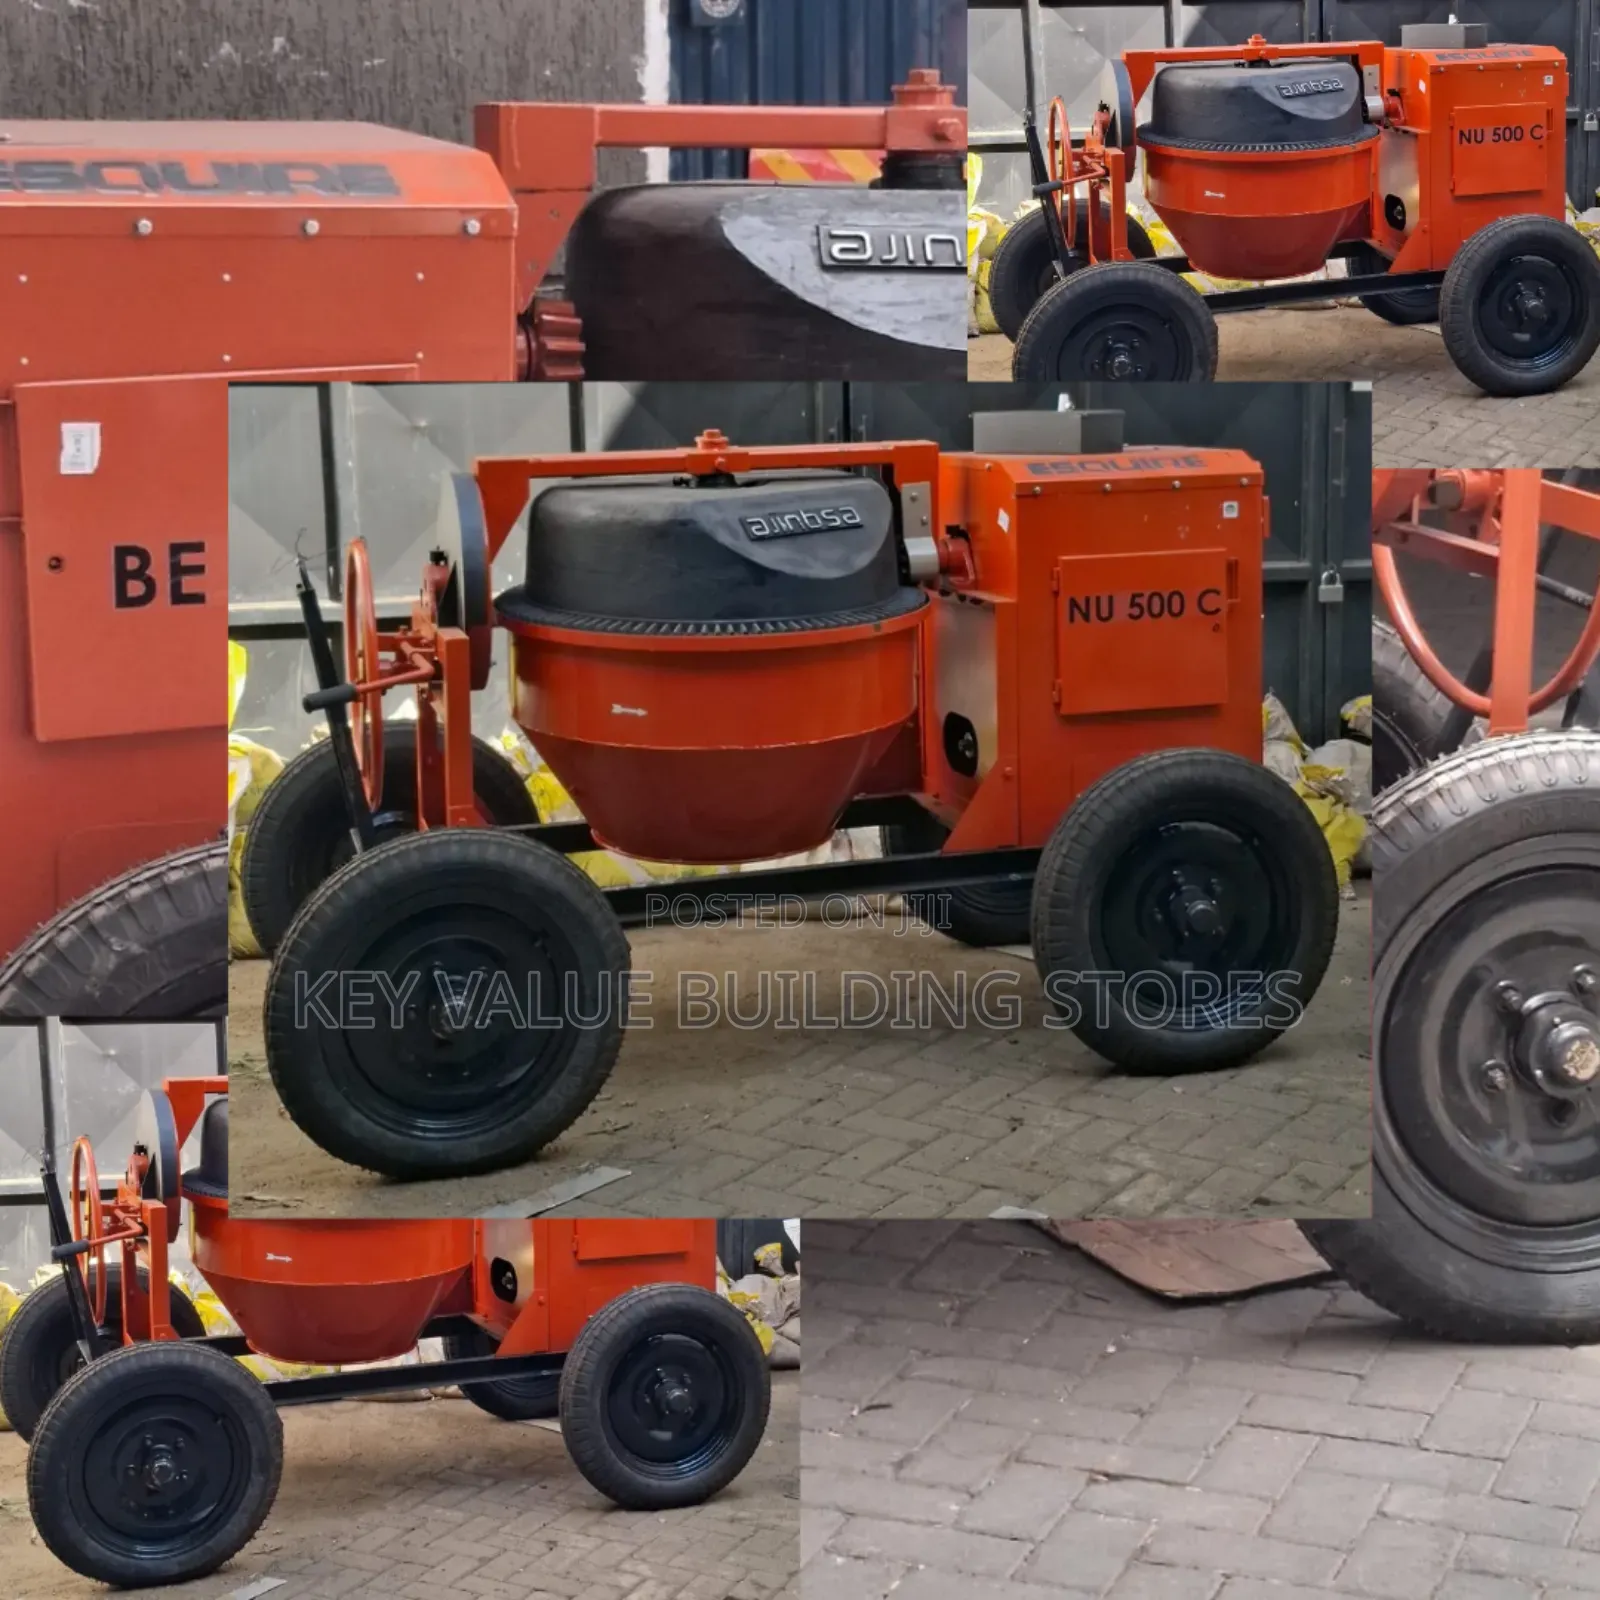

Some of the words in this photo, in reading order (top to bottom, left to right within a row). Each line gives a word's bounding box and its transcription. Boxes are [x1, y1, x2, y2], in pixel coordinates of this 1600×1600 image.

[1459, 128, 1484, 144] NU
[1492, 125, 1524, 142] 500
[1530, 124, 1544, 140] C
[0, 161, 401, 196] SQUIRE
[113, 541, 206, 609] BE
[1068, 595, 1114, 623] NU
[1128, 590, 1185, 620] 500
[1197, 588, 1222, 615] C
